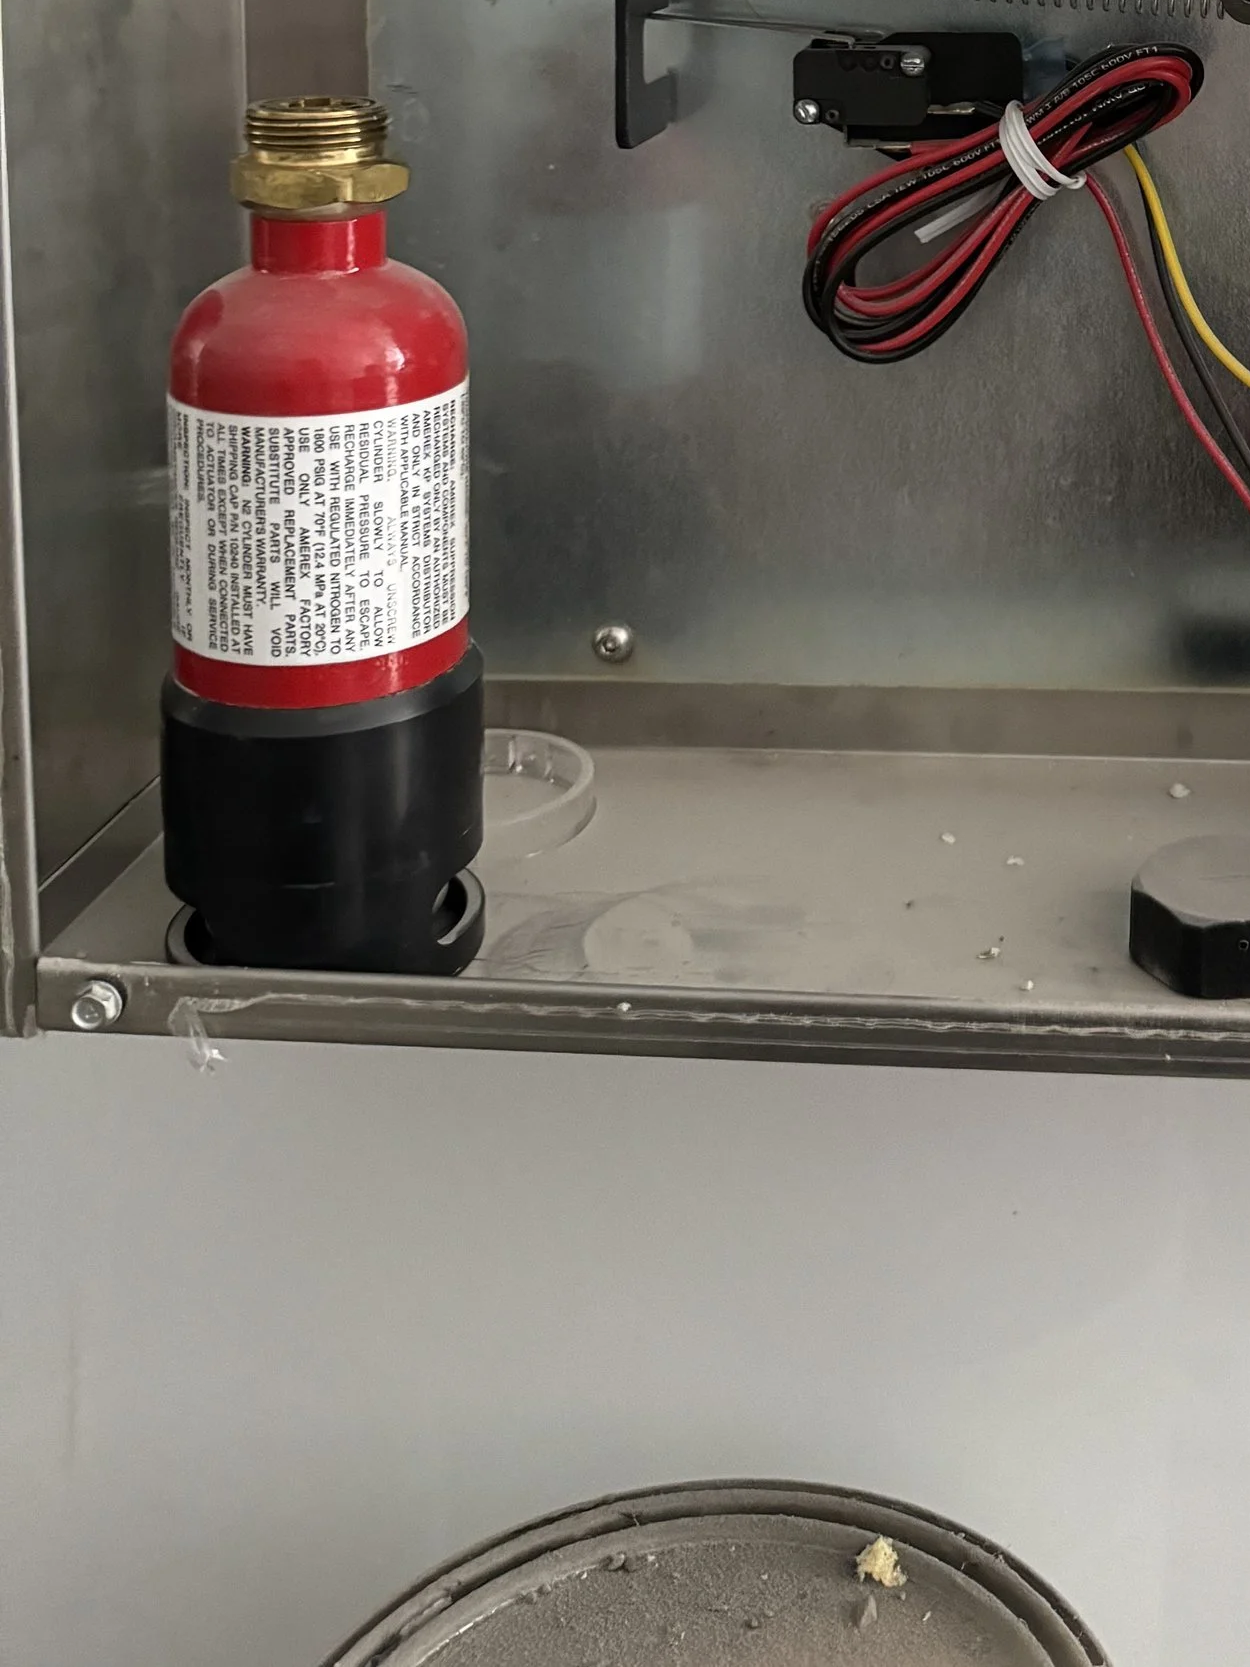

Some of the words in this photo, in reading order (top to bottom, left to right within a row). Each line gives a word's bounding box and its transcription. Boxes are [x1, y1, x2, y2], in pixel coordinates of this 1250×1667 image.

[207, 422, 216, 437] TO
[218, 424, 227, 444] ALL
[299, 428, 310, 452] USE
[314, 428, 325, 452] 1800
[330, 426, 340, 449] USE
[400, 415, 408, 445] WITH
[412, 413, 420, 437] AND
[423, 410, 431, 458] AMEREX
[218, 449, 227, 484] TIMES
[229, 425, 239, 480] SHIPPING
[242, 427, 252, 488] WARNING:
[269, 428, 281, 504] SUBSTITUTE
[284, 428, 295, 495] APPROVED
[345, 425, 355, 490] RECHARGE
[359, 423, 369, 483] RESIDUAL
[373, 421, 383, 482] CYLINDER
[412, 446, 420, 476] ONLY
[207, 445, 216, 511] ACTUATOR
[255, 427, 265, 534] MANUFACTURER'S
[299, 474, 310, 506] ONLY
[314, 459, 325, 486] PSIG
[330, 462, 340, 490] WITH
[400, 449, 408, 517] APPLICABLE
[412, 486, 420, 497] IN
[423, 468, 431, 482] KP
[218, 489, 228, 535] EXCEPT
[229, 485, 239, 509] CAP
[242, 500, 252, 515] N2
[314, 492, 325, 506] AT
[207, 519, 216, 536] OR
[229, 513, 239, 532] P/N
[330, 497, 340, 567] REGULATED
[345, 498, 355, 577] IMMEDIATELY
[359, 495, 369, 559] PRESSURE
[373, 502, 383, 550] SLOWLY
[412, 506, 420, 546] STRICT
[423, 492, 431, 547] SYSTEMS
[218, 540, 228, 575] WHEN
[229, 538, 239, 569] 10240
[242, 521, 252, 579] CYLINDER
[269, 523, 281, 563] PARTS
[284, 510, 295, 599] REPLACEMENT
[299, 528, 310, 578] AMEREX
[314, 543, 325, 569] (12.4
[387, 517, 396, 565] ALWAYS
[207, 544, 217, 590] DURING
[255, 538, 265, 606] WARRANTY.
[314, 574, 325, 598] MPa
[359, 572, 369, 587] TO
[373, 571, 383, 587] TO
[229, 573, 239, 635] INSTALLED
[242, 586, 252, 618] MUST
[269, 582, 281, 610] WILL
[314, 603, 325, 618] AT
[330, 573, 340, 633] NITROGEN
[345, 584, 355, 622] AFTER
[387, 583, 396, 644] UNSCREW
[412, 556, 420, 637] ACCORDANCE
[423, 556, 431, 633] DISTRIBUTOR
[207, 598, 217, 649] SERVICE
[218, 580, 228, 652] CONNECTED
[284, 614, 295, 657] PARTS.
[299, 599, 310, 656] FACTORY
[359, 600, 369, 651] ESCAPE.
[373, 607, 383, 647] ALLOW
[230, 639, 240, 654] AT
[242, 624, 252, 655] HAVE
[269, 628, 281, 657] VOID
[330, 639, 340, 654] TO
[345, 629, 355, 652] ANY
